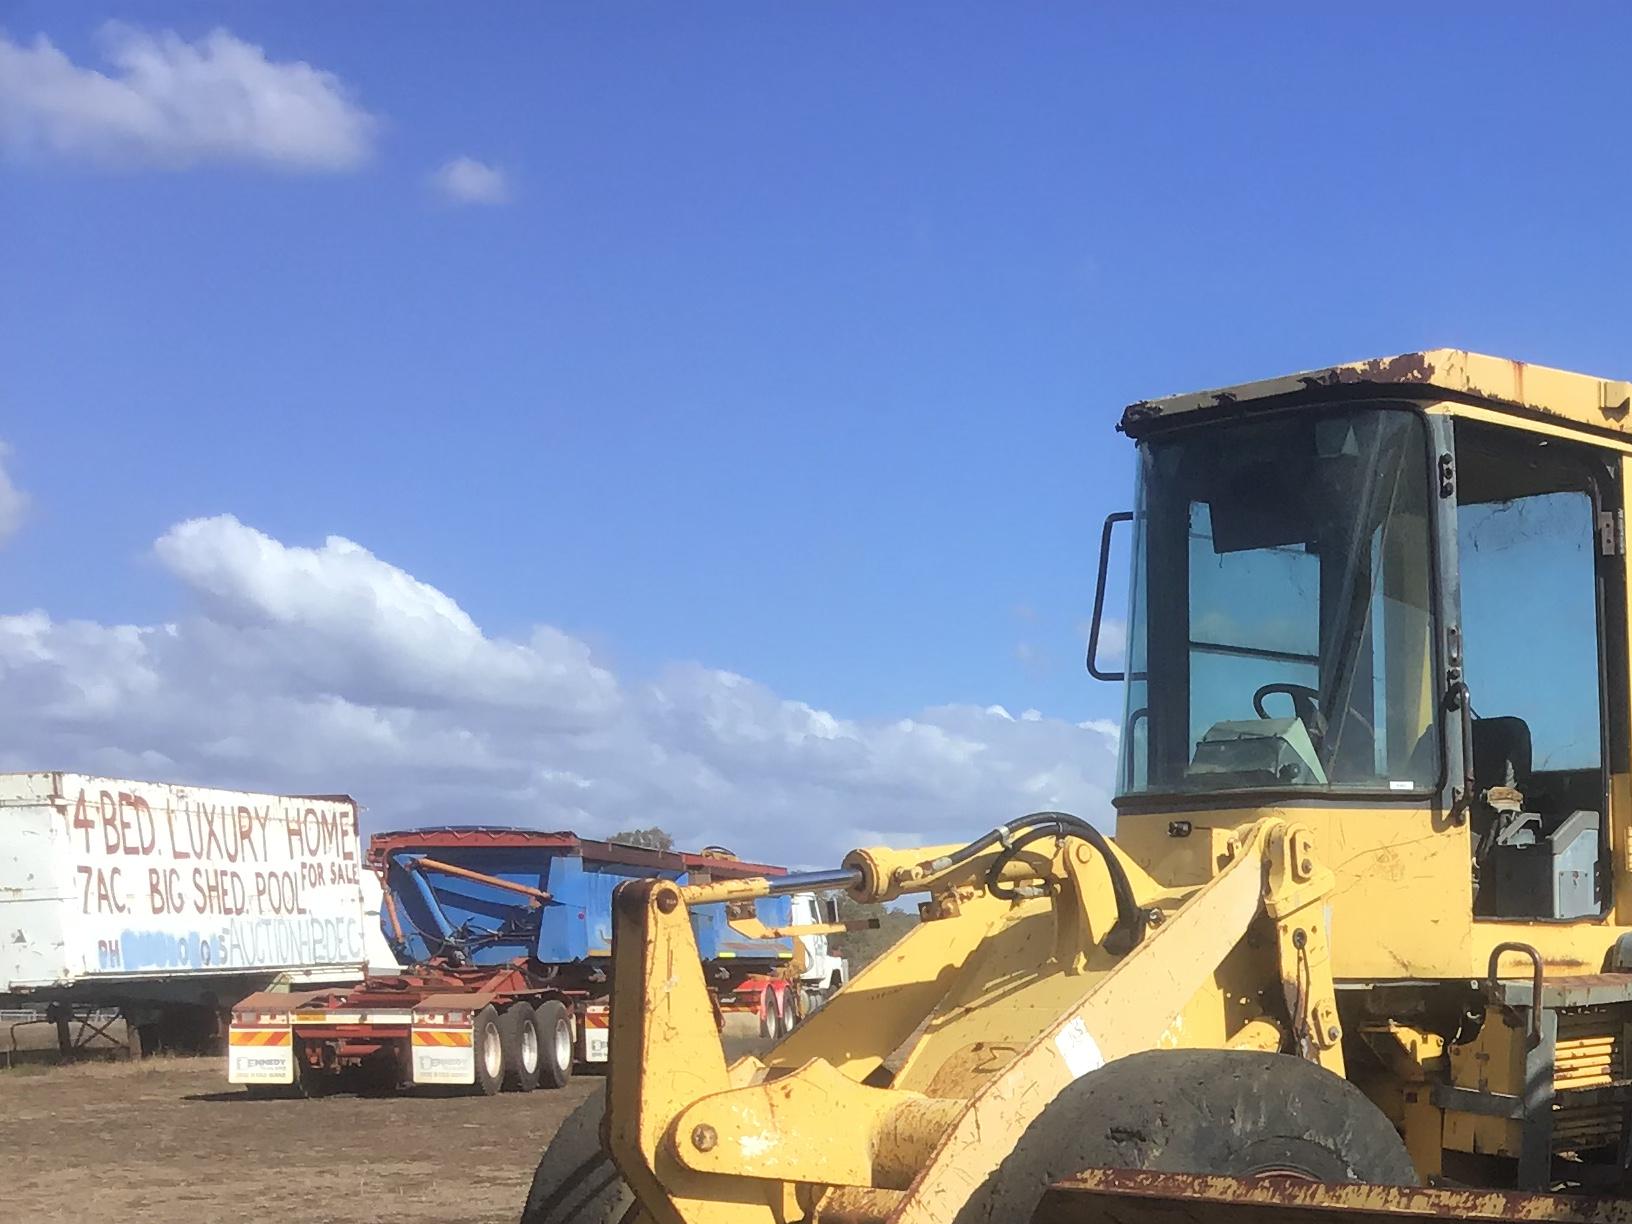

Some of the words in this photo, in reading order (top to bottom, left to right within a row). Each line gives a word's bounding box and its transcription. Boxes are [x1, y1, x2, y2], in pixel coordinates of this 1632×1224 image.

[73, 788, 95, 854] 4
[166, 798, 270, 863] LUXURY
[285, 807, 354, 861] HOME
[148, 868, 185, 914] BIG
[301, 862, 325, 891] FOR
[330, 862, 359, 884] SALE
